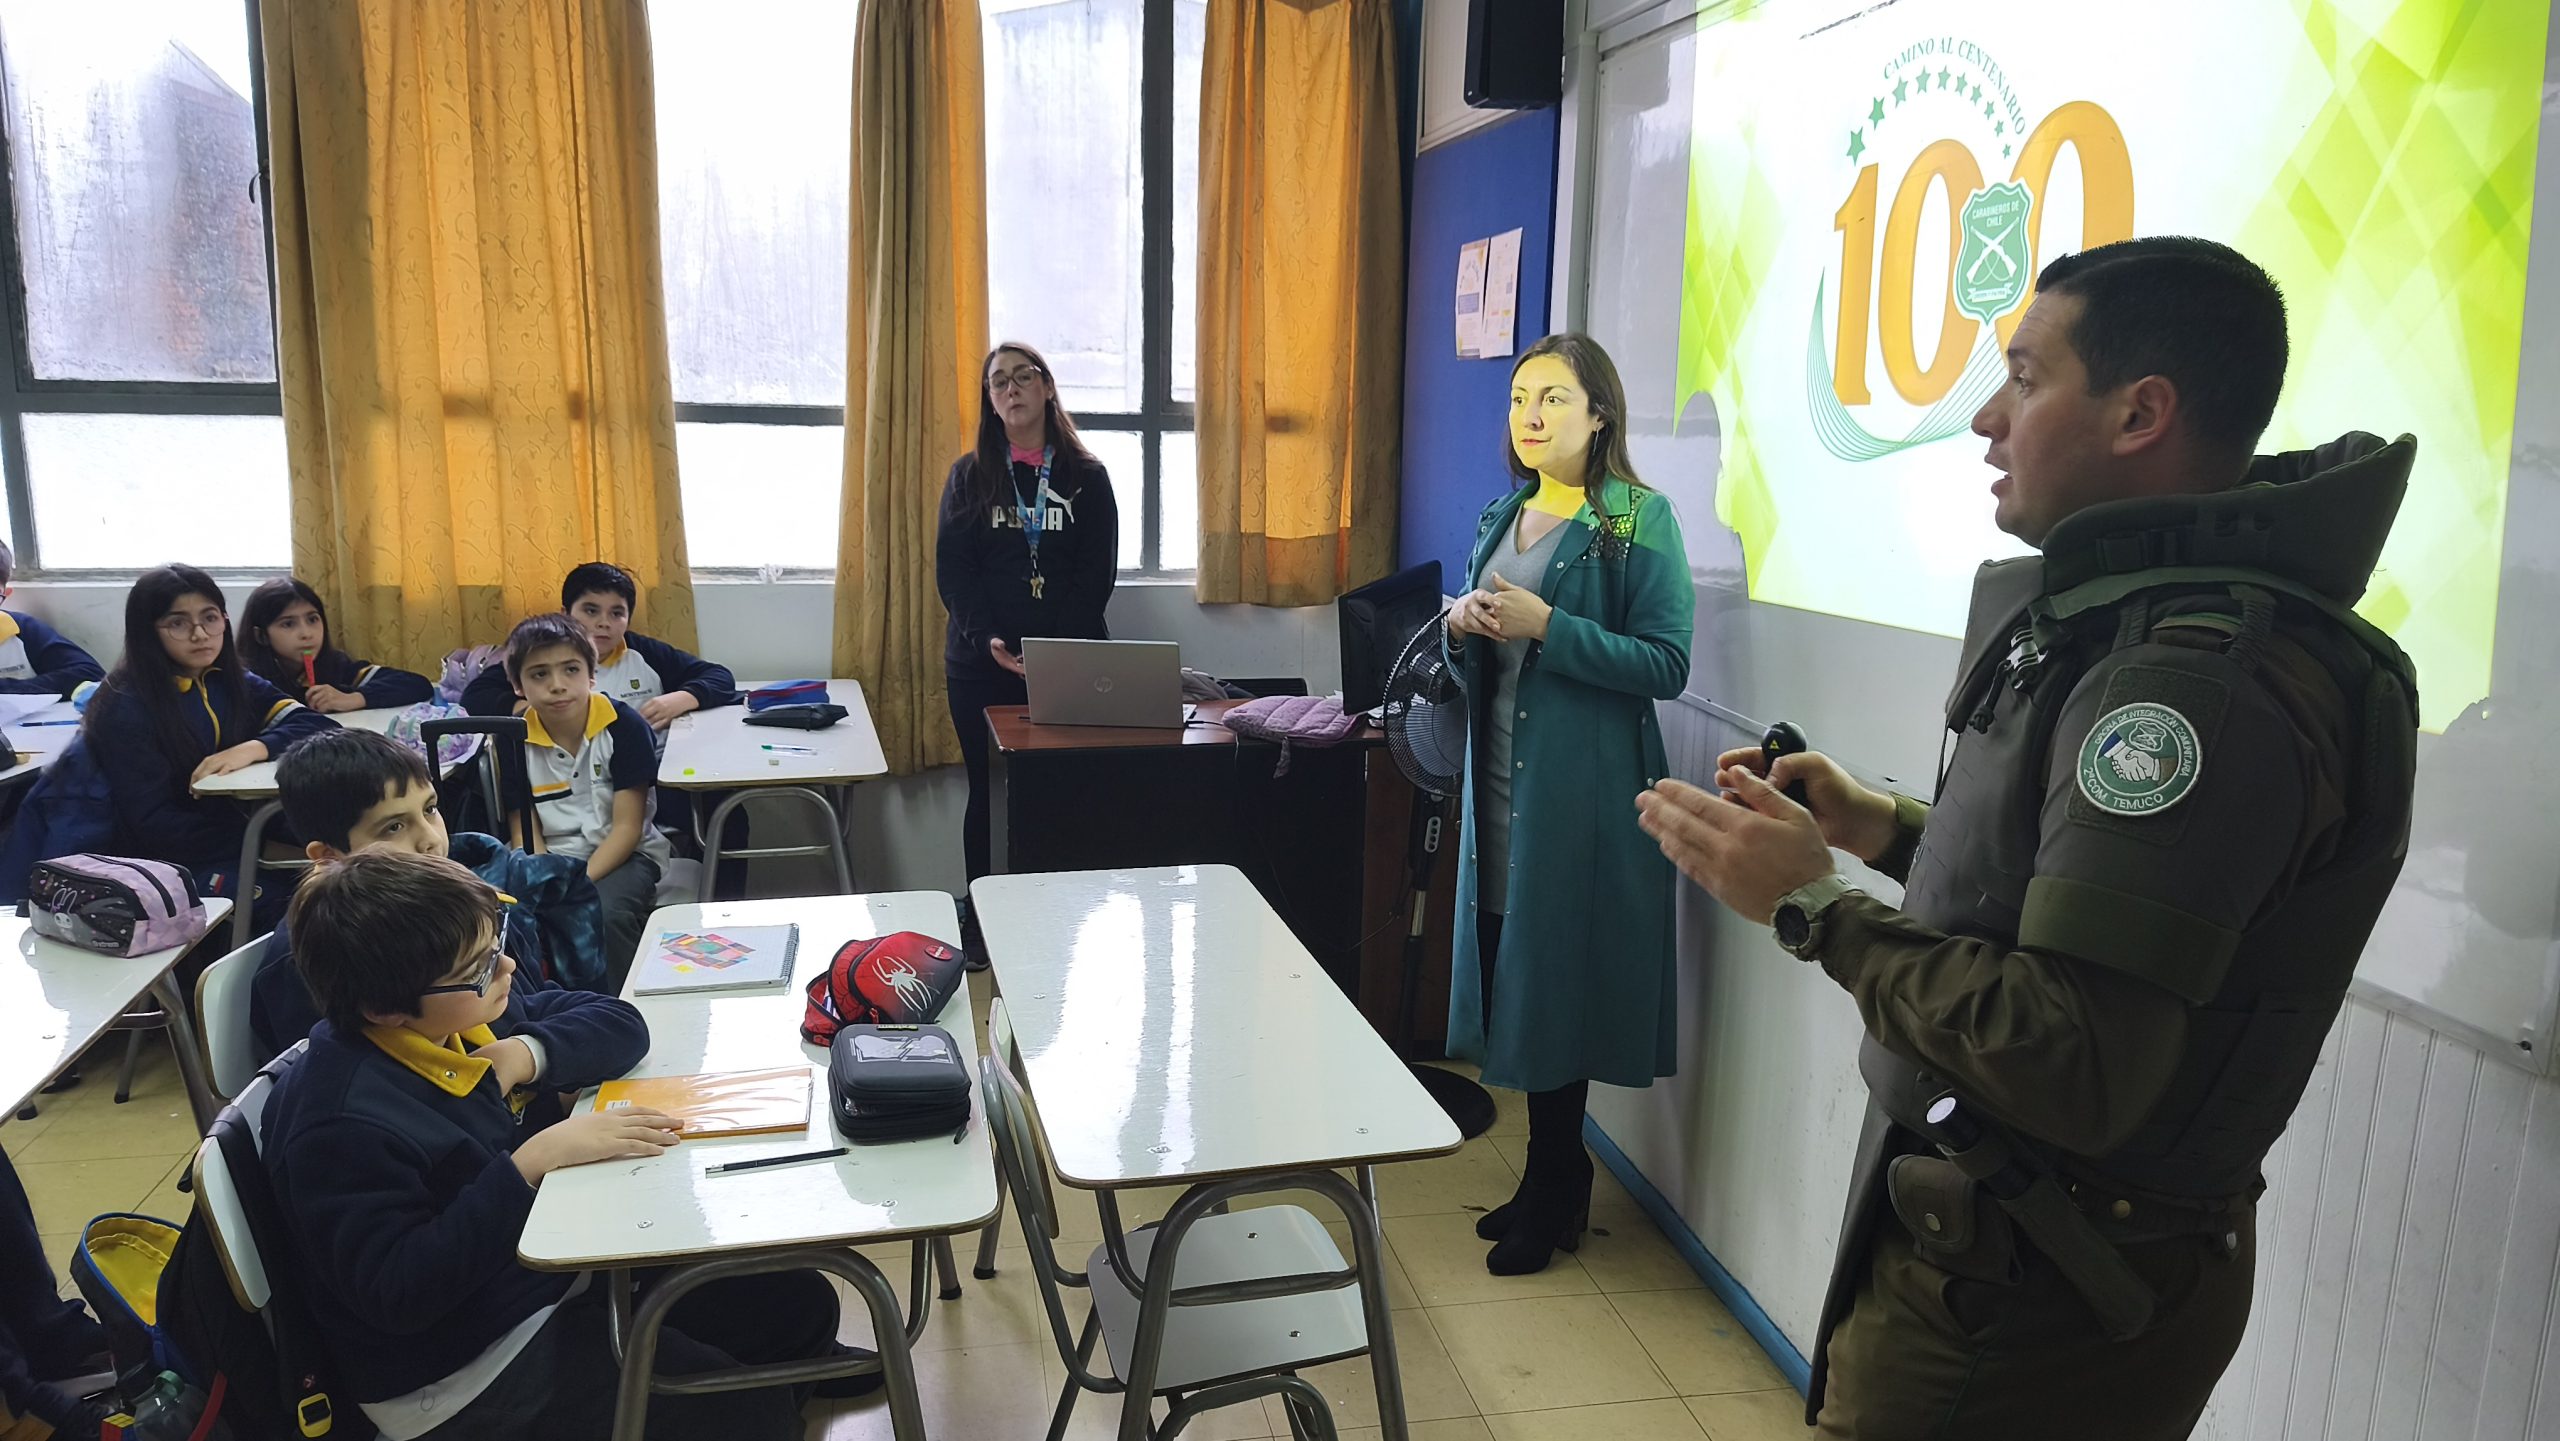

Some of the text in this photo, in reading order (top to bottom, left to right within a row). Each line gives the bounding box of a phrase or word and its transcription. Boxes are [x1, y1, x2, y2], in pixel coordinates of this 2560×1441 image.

[1884, 36, 2026, 135] CAMINO AL CENTENARIO
[1972, 200, 2019, 220] CARABINEROS DE
[1986, 215, 2003, 228] CHILE
[1834, 101, 2134, 406] 100
[2118, 713, 2129, 724] DE
[2113, 793, 2164, 809] TEMUCO
